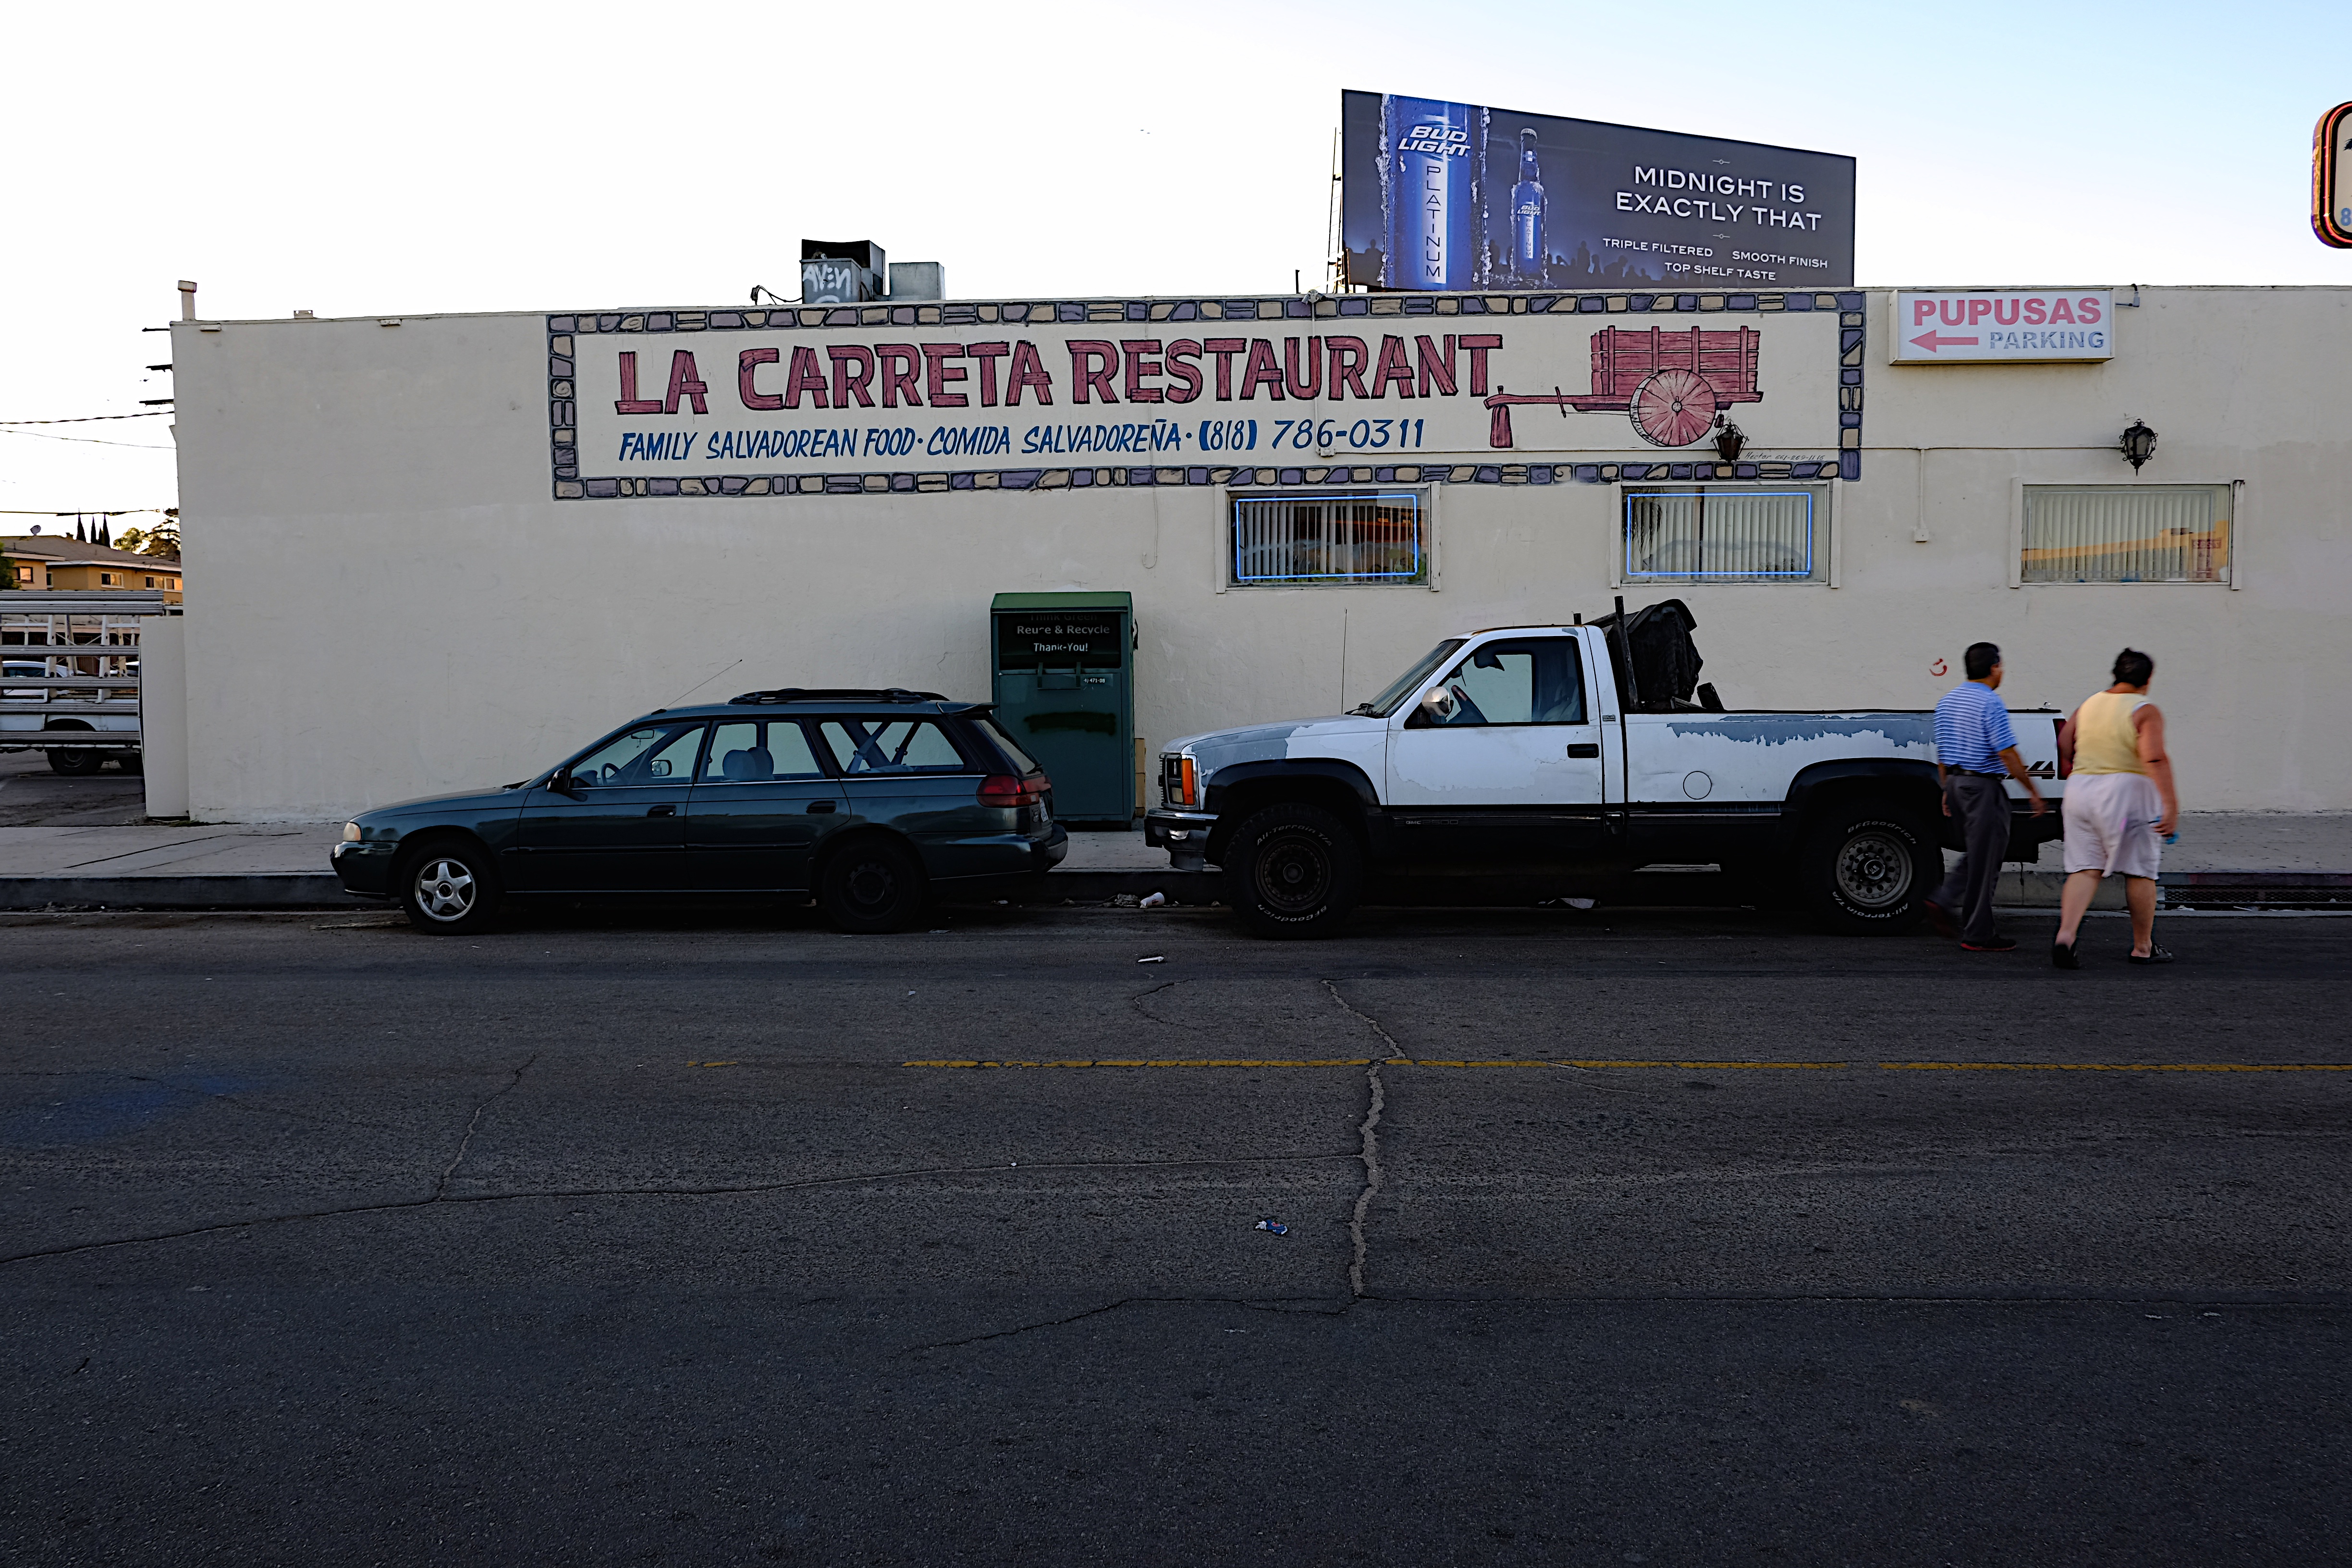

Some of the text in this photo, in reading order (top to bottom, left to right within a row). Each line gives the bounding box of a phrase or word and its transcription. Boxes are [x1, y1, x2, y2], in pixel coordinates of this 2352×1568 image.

[1409, 125, 1467, 143] BUD
[1397, 137, 1471, 157] LIGHT
[1634, 165, 1805, 203] MIDNIGHT IS
[1425, 165, 1441, 278] PLATINUM
[1616, 191, 1822, 232] EXACTLY THAT
[1602, 238, 1828, 269] TRIPLE FILTERED SMOOTH FINISH
[1664, 261, 1776, 281] TOP SHELF TASTE
[1914, 297, 2102, 326] PUPUSAS
[1989, 331, 2104, 349] PARKING
[614, 333, 1503, 415] LA CARRETA RESTAURANT
[618, 418, 1425, 462] FAMILY SALVADOREAN FOOD COMIDA SALVADOREÑA (818) 786-0311
[1745, 451, 1772, 460] Hector
[1054, 625, 1063, 634] &
[1067, 625, 1110, 636] Recycle
[1256, 824, 1333, 847] All-Terrain T/A
[1847, 820, 1917, 845] BFGoodrich
[1257, 904, 1328, 922] BFGoodrich
[1831, 890, 1909, 919] All-Terrain T/A
